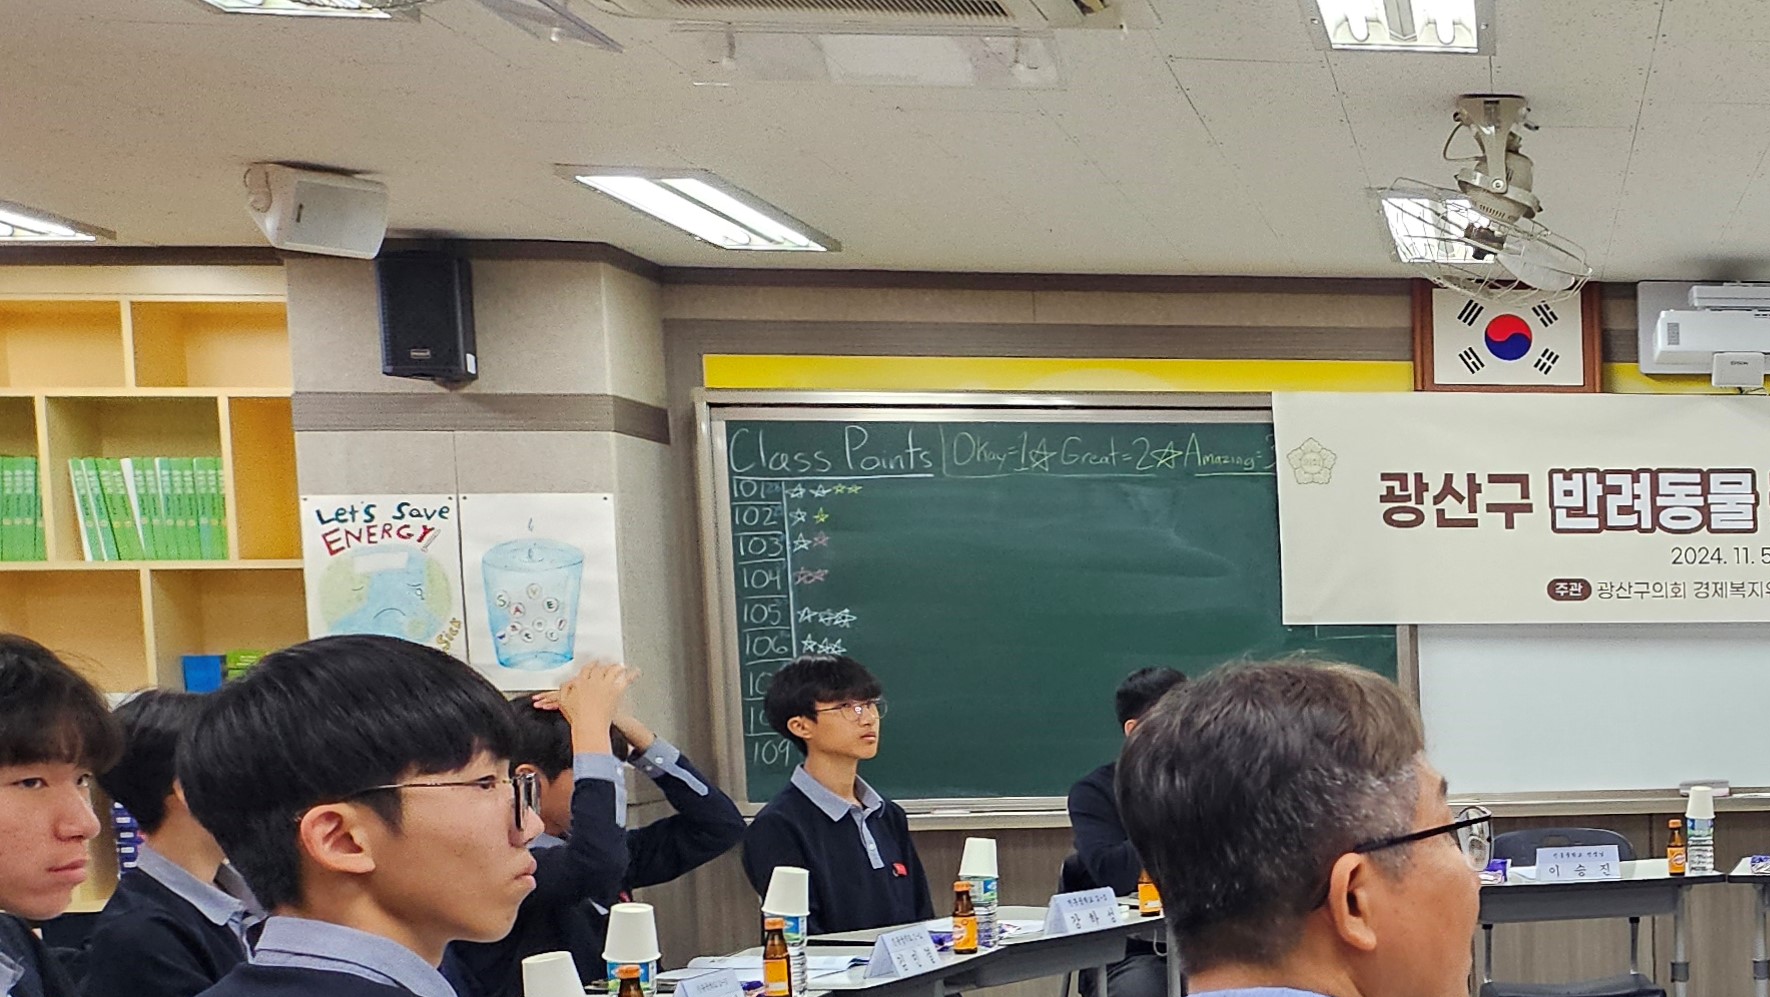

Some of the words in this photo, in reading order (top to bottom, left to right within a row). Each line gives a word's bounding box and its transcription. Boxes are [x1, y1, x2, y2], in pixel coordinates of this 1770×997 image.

[729, 428, 832, 472] Class
[844, 425, 933, 470] Points
[733, 478, 766, 499] 101
[1379, 472, 1533, 530] 광산구
[1549, 468, 1759, 534] 반려동물
[315, 501, 377, 526] Let's
[391, 502, 451, 521] Save
[735, 506, 778, 526] 102
[739, 535, 784, 557] 103
[1671, 546, 1728, 566] 2024.
[1733, 547, 1755, 565] 11.
[743, 567, 782, 591] 104
[1554, 582, 1584, 598] 주관
[1597, 579, 1687, 600] 광산구의회
[744, 603, 782, 626] 105
[746, 633, 788, 656] 106
[754, 738, 792, 768] 109
